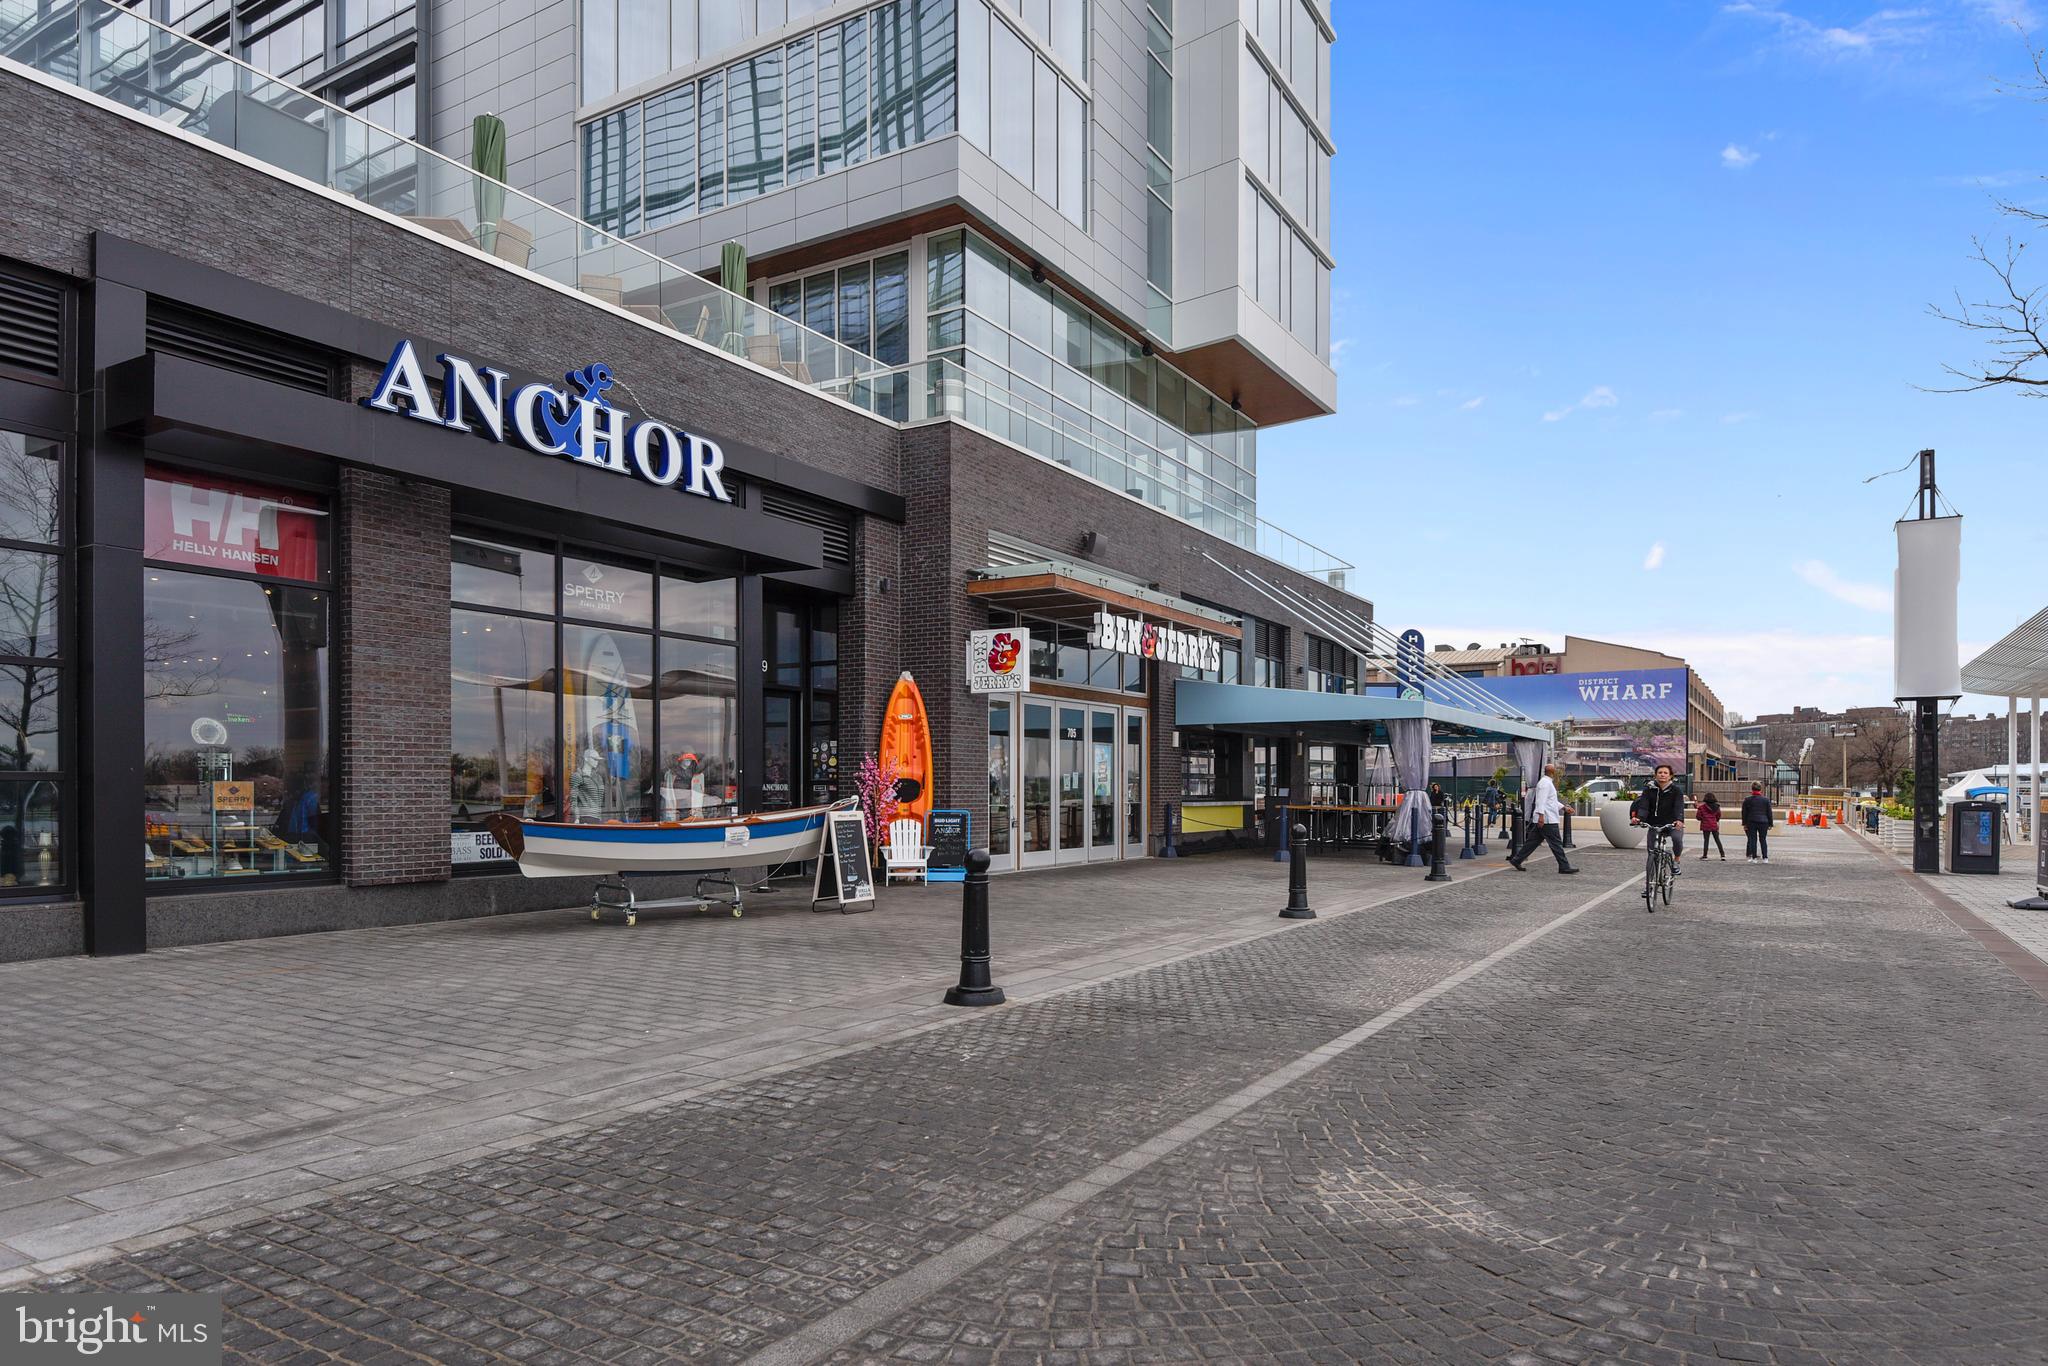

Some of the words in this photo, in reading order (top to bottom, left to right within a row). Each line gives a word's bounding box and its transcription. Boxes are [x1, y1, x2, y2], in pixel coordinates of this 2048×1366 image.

[366, 339, 732, 502] ANCHOR
[172, 539, 218, 557] HELLY
[221, 548, 280, 567] HANSEN
[563, 583, 625, 605] SPERRY
[1101, 612, 1144, 656] BEN
[1154, 626, 1221, 673] JERRY'S
[761, 659, 768, 672] 9
[973, 636, 988, 675] BEN
[1511, 655, 1562, 676] hotel
[973, 673, 1021, 690] JERRY'S
[1578, 678, 1620, 686] DISTRICT
[1578, 683, 1673, 702] WHARF
[480, 847, 503, 859] SOLD
